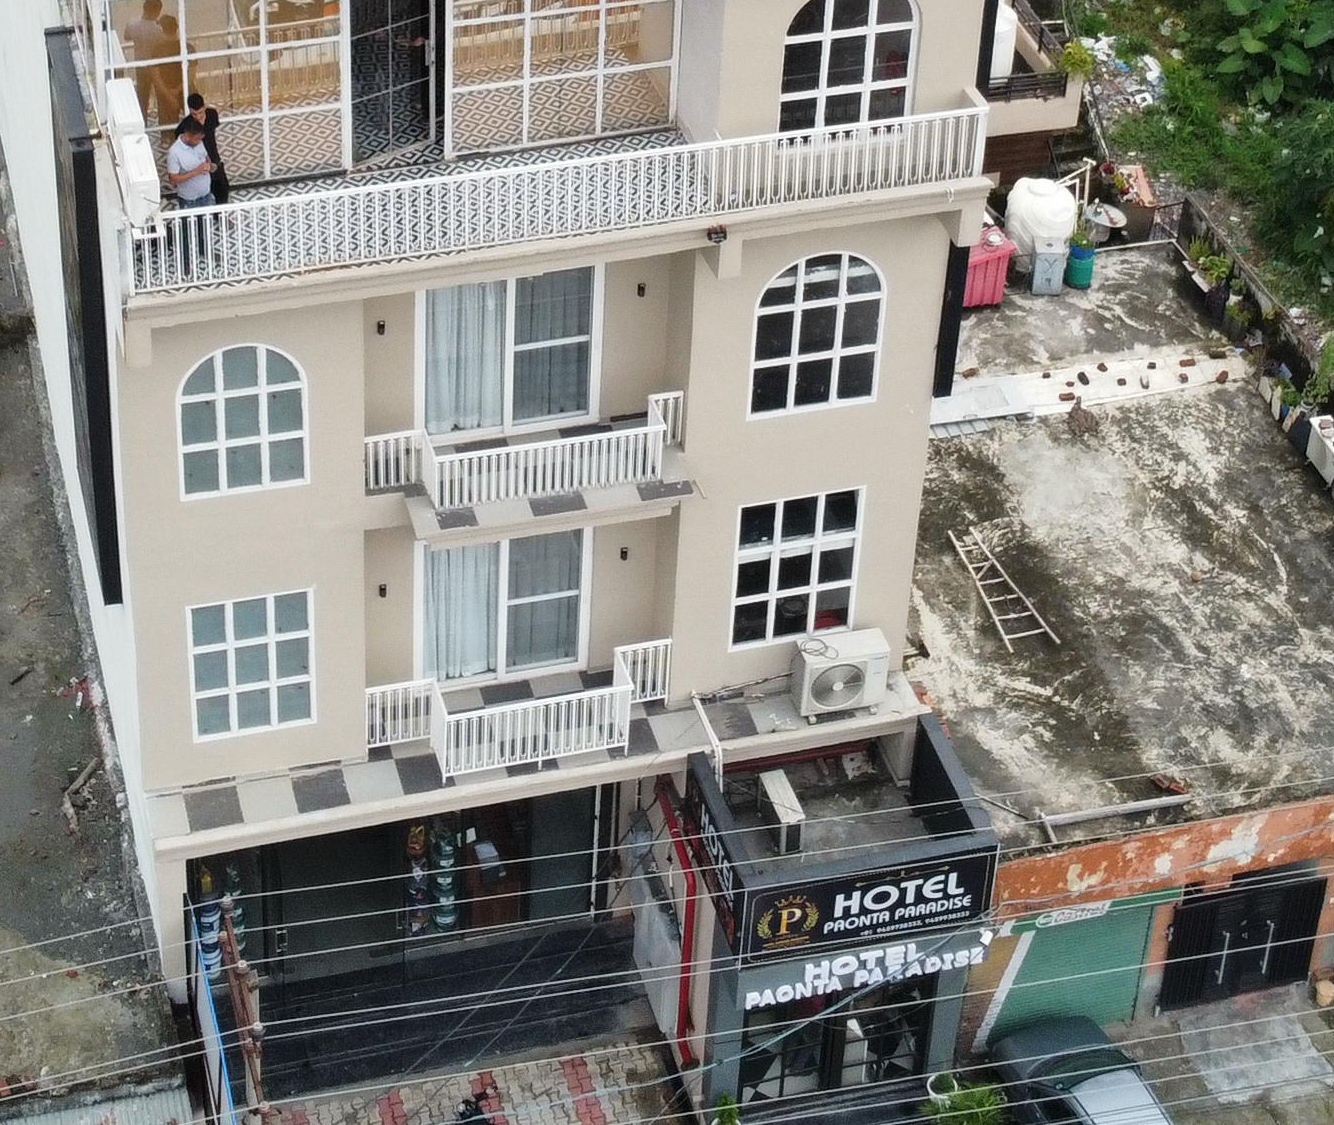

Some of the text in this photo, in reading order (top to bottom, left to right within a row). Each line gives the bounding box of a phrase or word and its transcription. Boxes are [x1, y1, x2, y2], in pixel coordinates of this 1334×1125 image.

[823, 895, 972, 935] PAONTA PARADISE
[833, 872, 965, 918] HOTEL
[776, 908, 802, 935] P
[745, 947, 985, 1010] PAONTA PARADISE
[804, 943, 925, 983] HOTEL
